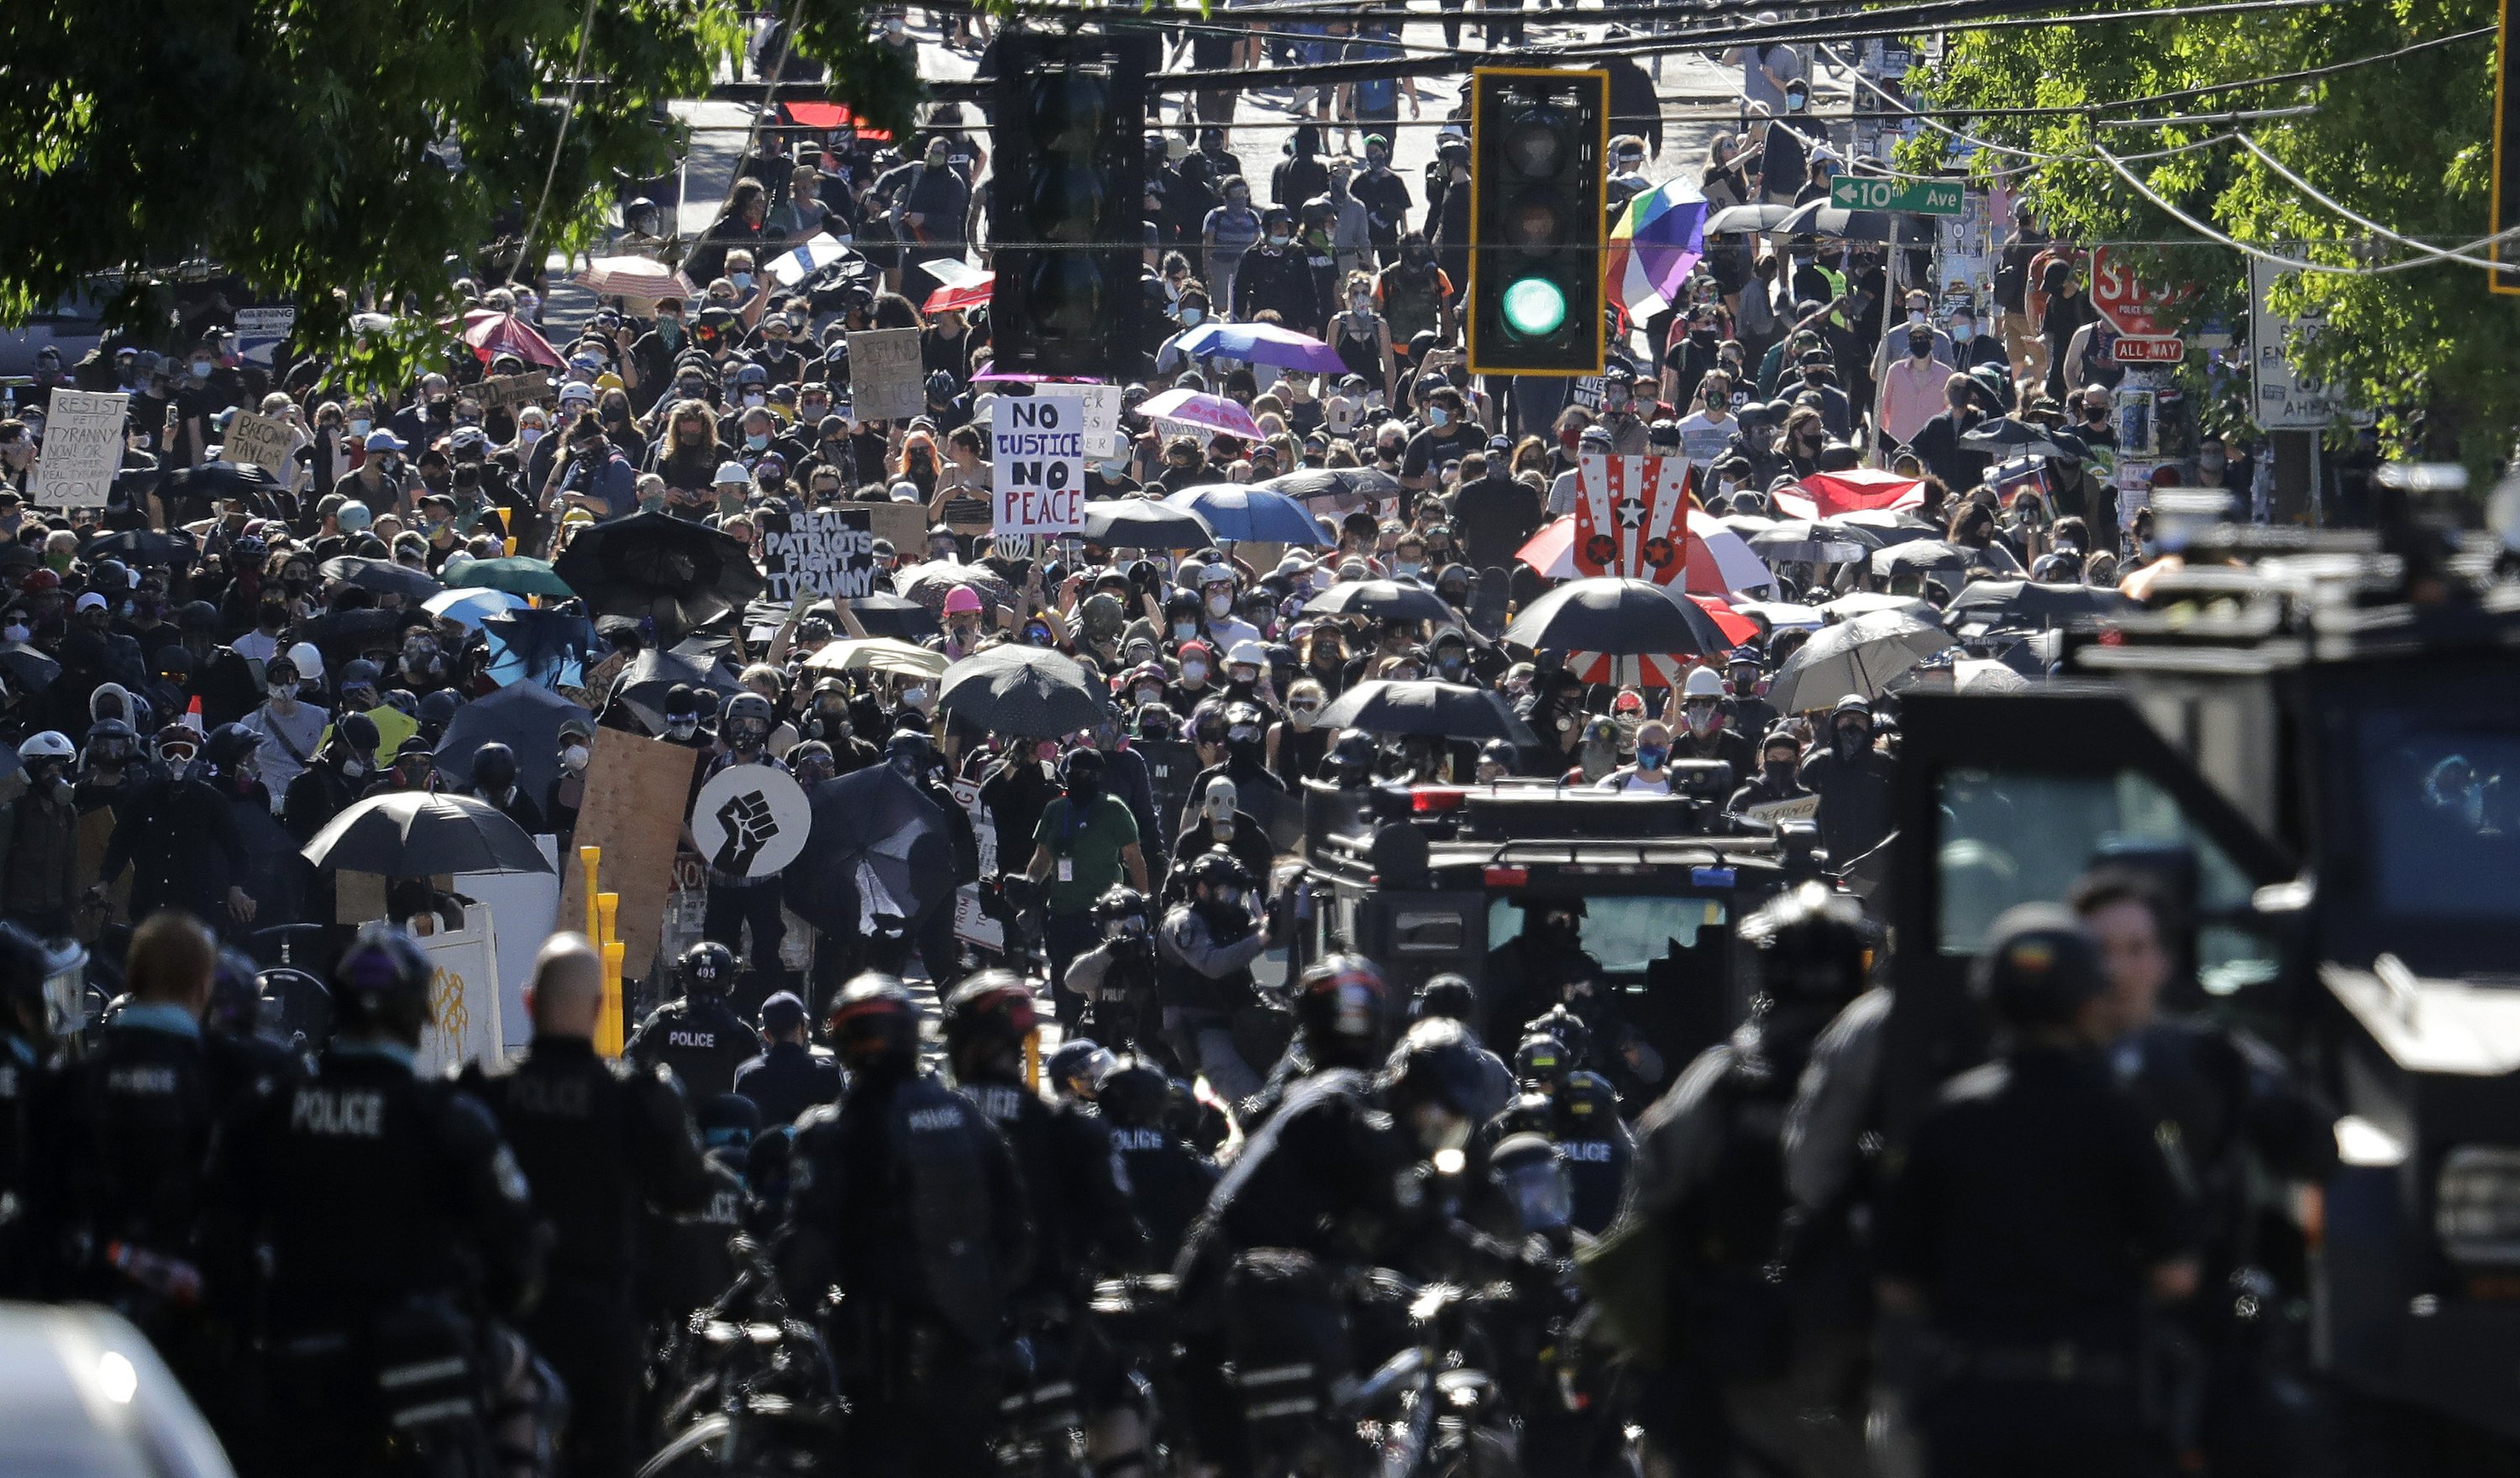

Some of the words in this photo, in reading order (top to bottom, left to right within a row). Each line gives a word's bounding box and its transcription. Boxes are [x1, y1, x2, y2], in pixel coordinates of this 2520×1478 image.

[1926, 189, 1957, 207] Ave
[2119, 343, 2144, 357] ALL
[2150, 343, 2177, 356] WAY
[57, 396, 127, 415] RESIST
[1012, 402, 1058, 429] NO
[48, 427, 118, 443] TYRANNY
[997, 432, 1082, 458] JUSTICE
[232, 437, 281, 466] TAYLOR
[1012, 461, 1068, 490] NO
[44, 480, 101, 500] SOON
[1005, 490, 1080, 526] PEACE
[789, 512, 842, 532] REAL
[765, 531, 873, 556] PATRIOTS
[784, 551, 855, 573] FIGHT
[766, 566, 874, 600] TYRANNY
[696, 967, 717, 979] 495
[669, 1031, 715, 1049] POLICE
[291, 1088, 384, 1137] POLICE
